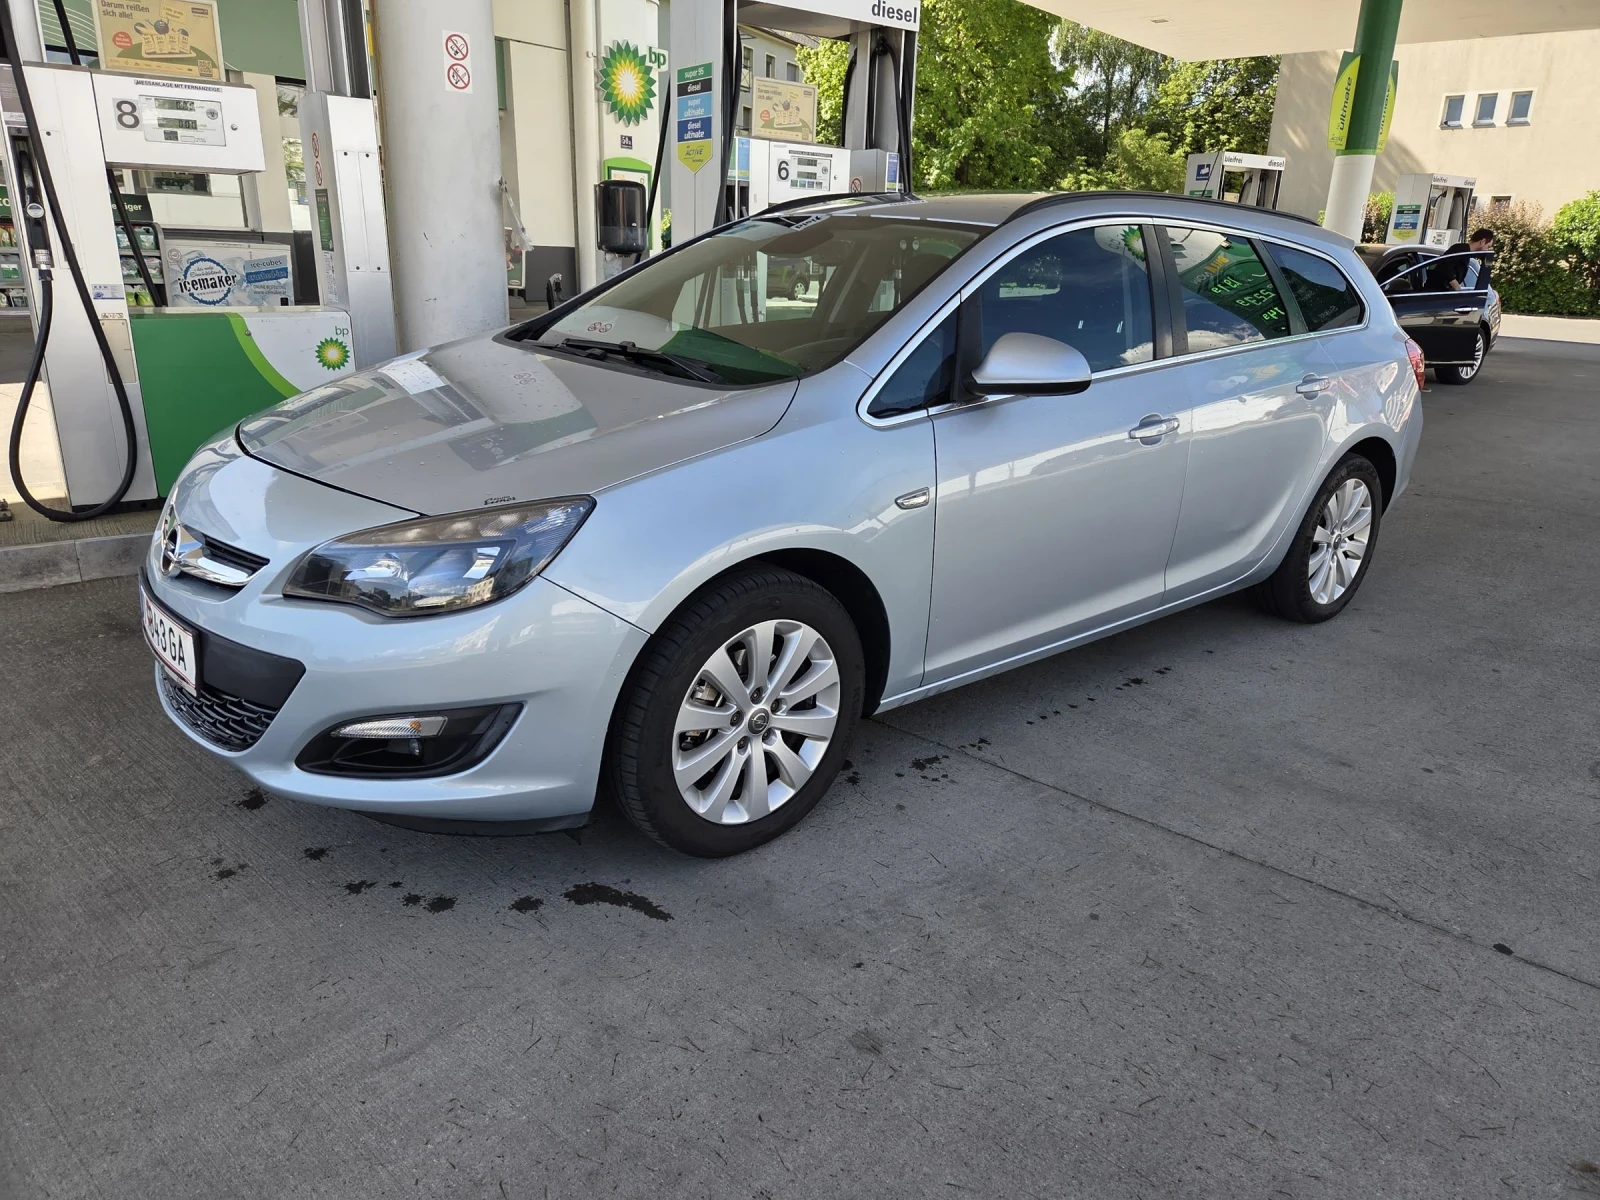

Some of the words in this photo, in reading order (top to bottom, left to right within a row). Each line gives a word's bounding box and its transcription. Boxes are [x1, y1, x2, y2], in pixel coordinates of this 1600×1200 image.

[101, 0, 125, 9] Darum
[126, 3, 150, 13] reißen
[871, 0, 918, 24] diesel
[102, 9, 117, 17] sich
[118, 10, 134, 19] alle!
[648, 46, 667, 69] bp
[684, 68, 698, 79] super
[697, 67, 705, 75] 95
[135, 80, 173, 88] MESSANLAGE
[184, 84, 221, 92] FERNANZEIGE
[687, 82, 702, 92] diesel
[1339, 76, 1353, 131] ultimate
[116, 100, 140, 129] 8
[687, 120, 702, 129] diesel
[684, 130, 705, 139] ultimate
[1224, 156, 1243, 164] bleifrei
[1268, 159, 1285, 167] diesel
[777, 160, 790, 180] 6
[111, 202, 142, 212] eiger
[250, 259, 282, 269] ice-cubes
[178, 274, 237, 293] icemaker
[334, 326, 349, 337] bp
